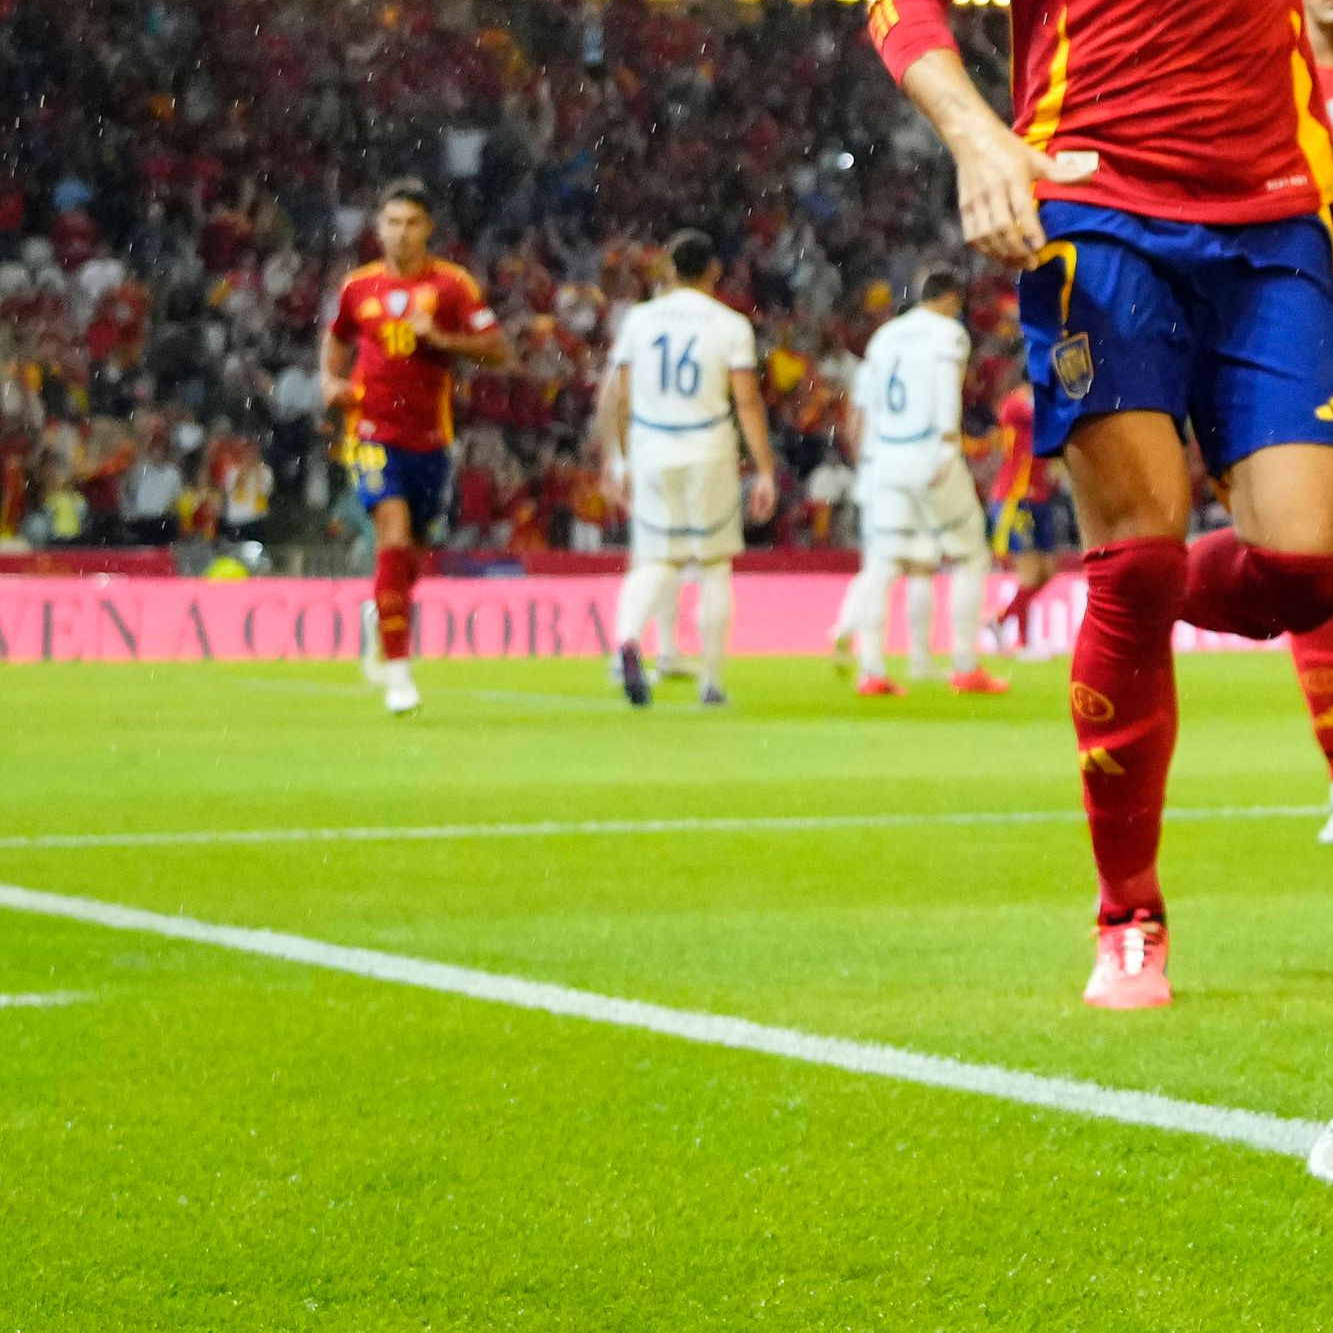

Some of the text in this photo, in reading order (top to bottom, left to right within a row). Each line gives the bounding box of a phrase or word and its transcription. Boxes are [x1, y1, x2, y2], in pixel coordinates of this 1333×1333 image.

[651, 331, 701, 400] 16
[885, 351, 908, 417] 6
[174, 599, 214, 661] A
